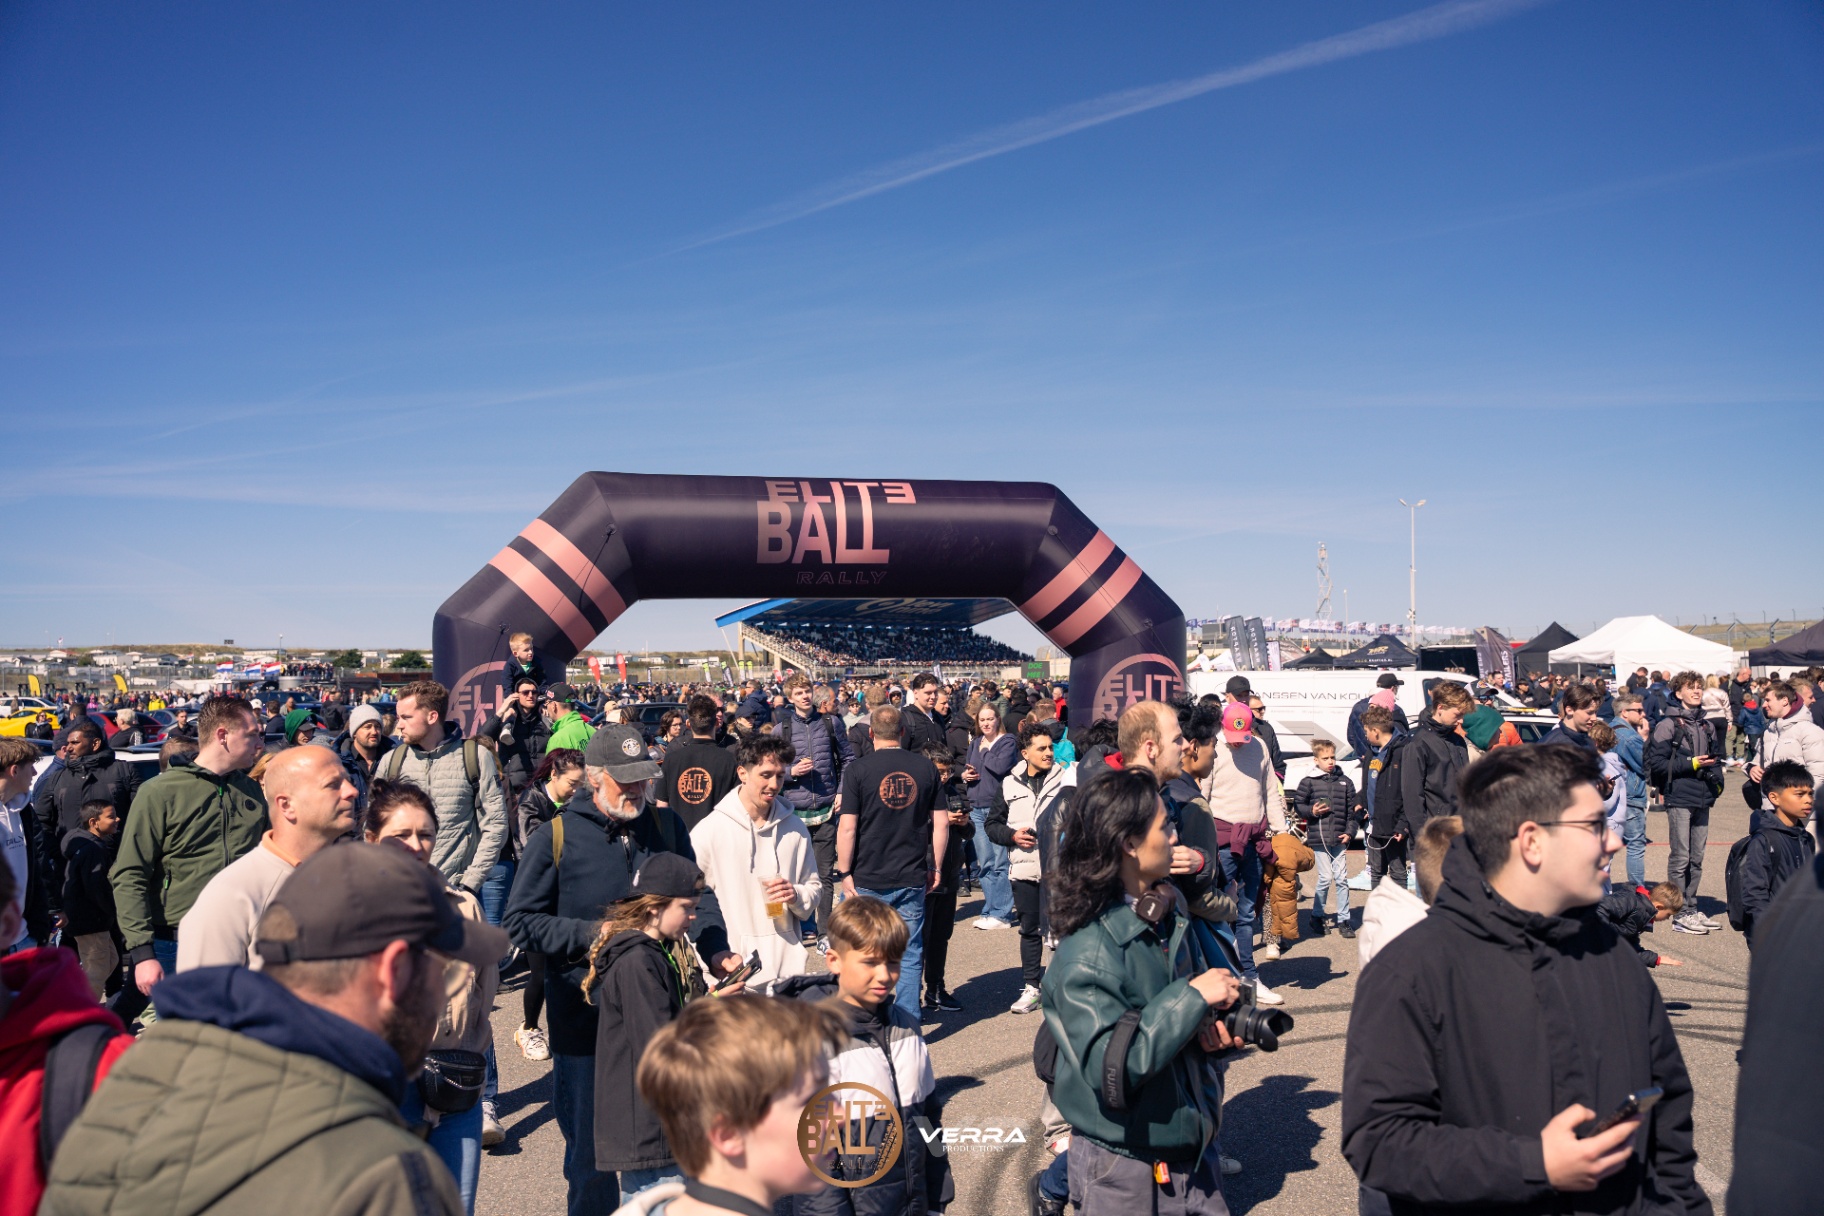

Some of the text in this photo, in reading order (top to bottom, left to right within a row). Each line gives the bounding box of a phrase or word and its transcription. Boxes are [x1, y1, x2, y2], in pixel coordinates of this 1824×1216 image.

[757, 500, 890, 564] BALL
[796, 571, 887, 584] RALLY
[1254, 692, 1307, 700] ANSSEN
[1310, 692, 1337, 700] VAN
